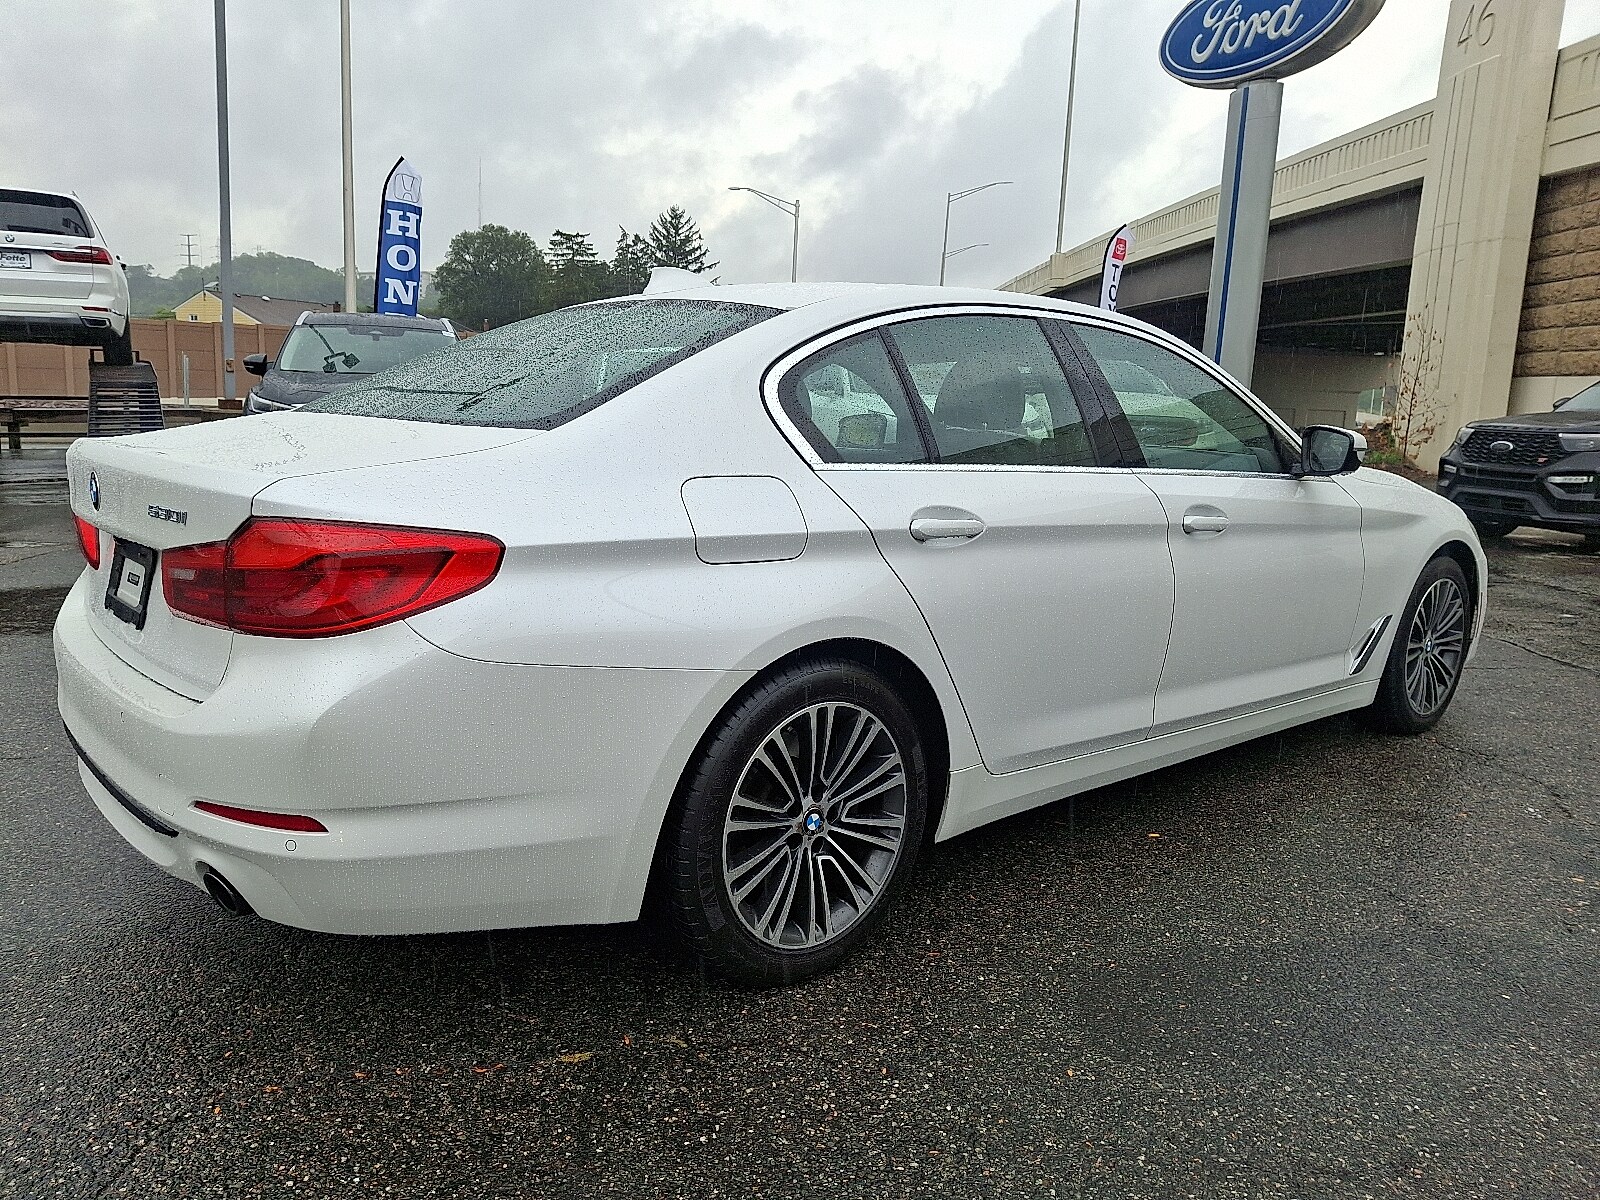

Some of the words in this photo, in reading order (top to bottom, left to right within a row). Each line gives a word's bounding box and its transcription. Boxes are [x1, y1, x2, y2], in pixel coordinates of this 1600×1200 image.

[1190, 0, 1304, 63] Ford
[1457, 0, 1496, 54] 46
[383, 209, 420, 316] HON
